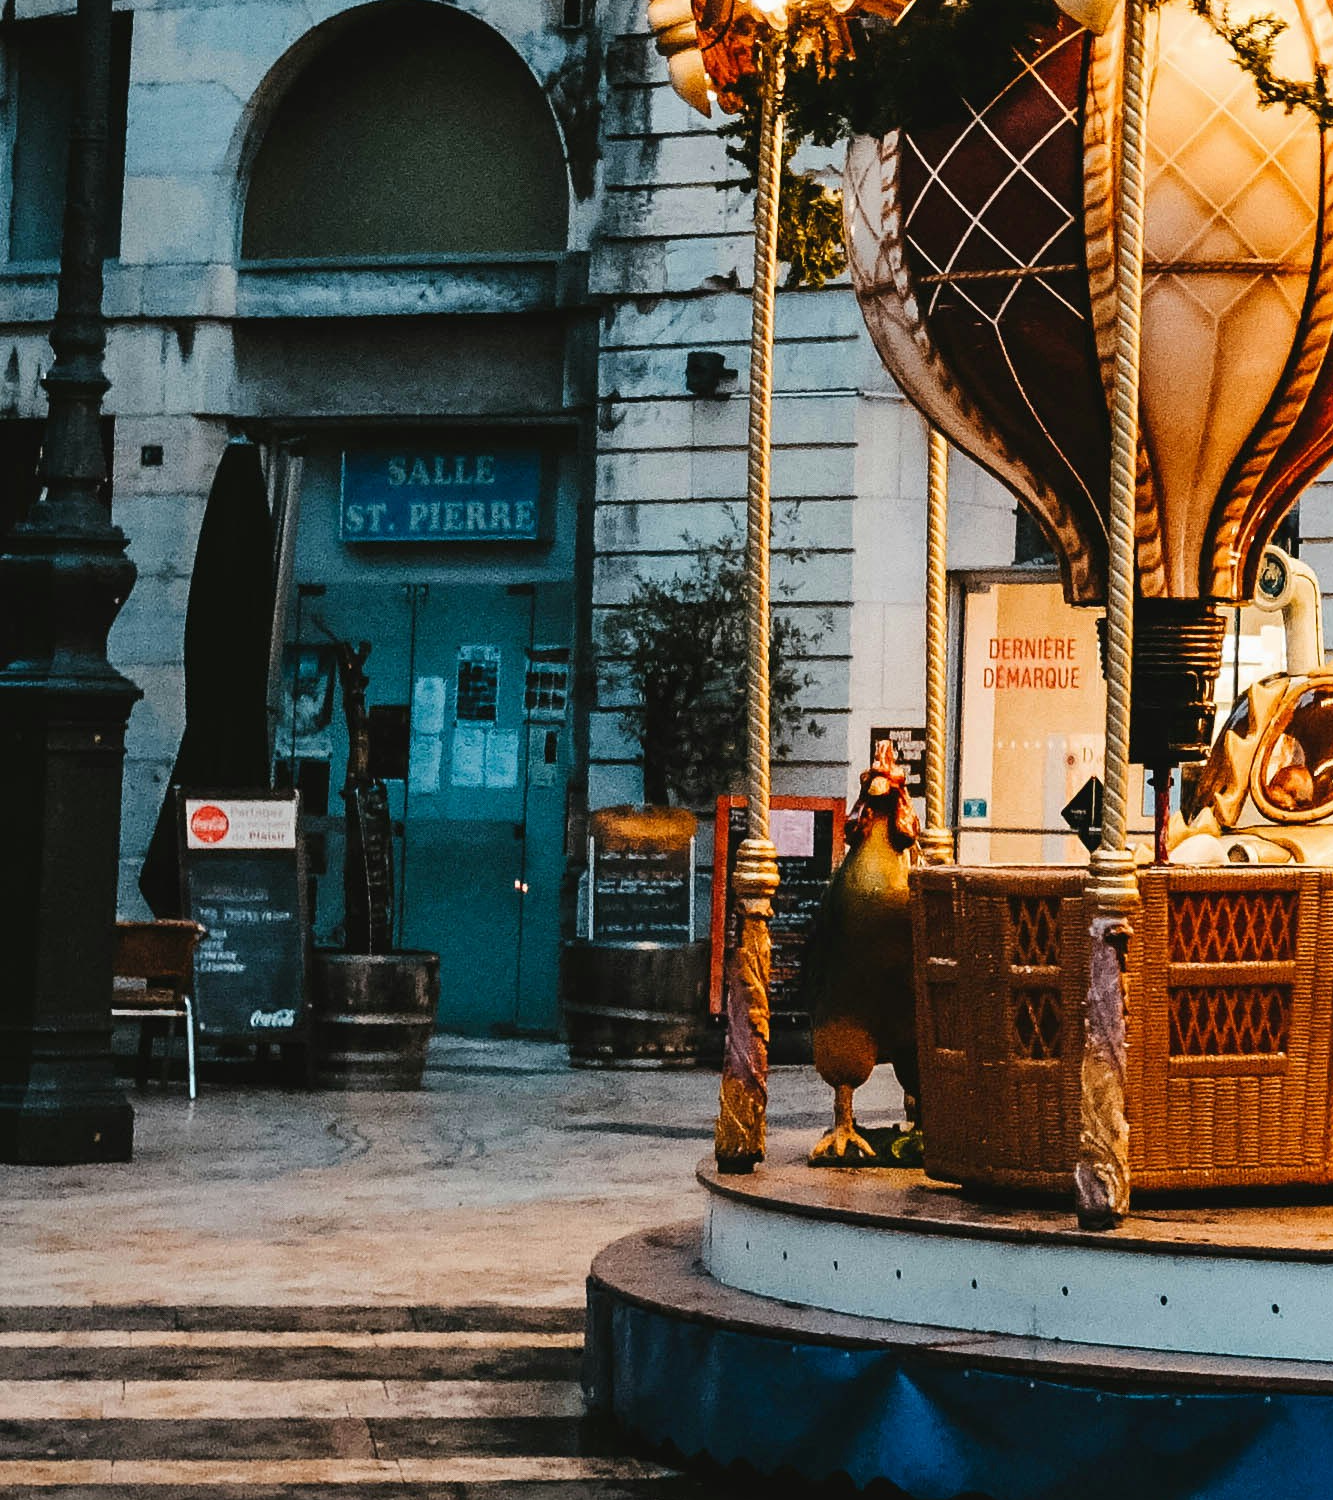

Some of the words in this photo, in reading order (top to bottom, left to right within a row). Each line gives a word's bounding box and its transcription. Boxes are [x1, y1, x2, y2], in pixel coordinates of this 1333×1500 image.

[388, 455, 495, 486] SALLE
[345, 502, 395, 533] ST.
[408, 500, 536, 532] PIERRE
[988, 636, 1078, 660] DERNIÈRE
[983, 665, 1080, 689] DÉMARQUE
